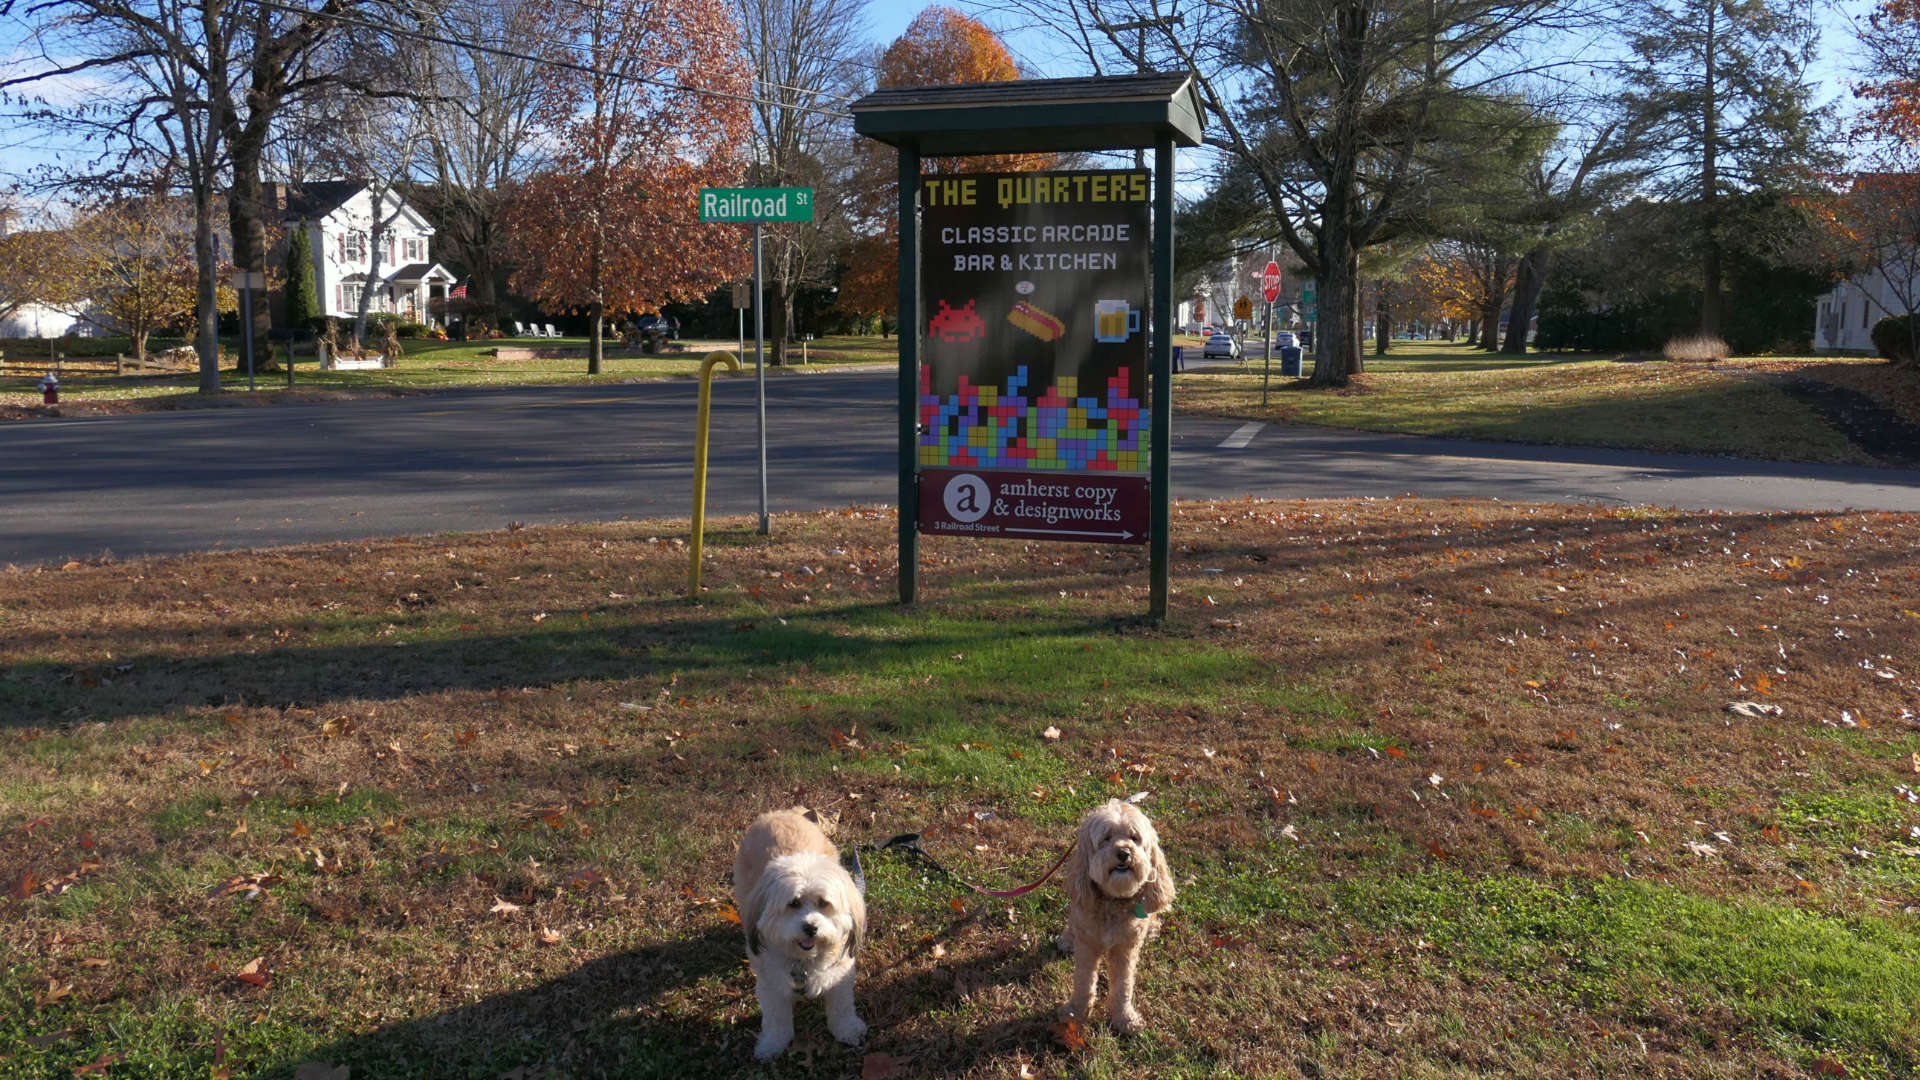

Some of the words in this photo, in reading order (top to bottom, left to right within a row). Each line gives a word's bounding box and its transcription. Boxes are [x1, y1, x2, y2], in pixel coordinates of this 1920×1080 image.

[926, 179, 977, 206] THE
[998, 174, 1146, 209] QUARTERS
[704, 193, 787, 217] Railroad
[796, 192, 808, 205] St
[941, 226, 1036, 244] CLASSIC
[1042, 224, 1130, 242] ARCADE
[954, 254, 995, 271] BAR
[1000, 255, 1012, 271] &
[1019, 253, 1116, 270] KITCHEN
[1264, 275, 1280, 290] STOP
[957, 484, 980, 512] a
[1000, 479, 1070, 498] amherst
[1075, 483, 1117, 505] copy
[993, 498, 1009, 516] &
[1014, 500, 1121, 523] designworks
[941, 522, 974, 531] Railroad
[975, 523, 1000, 533] Street
